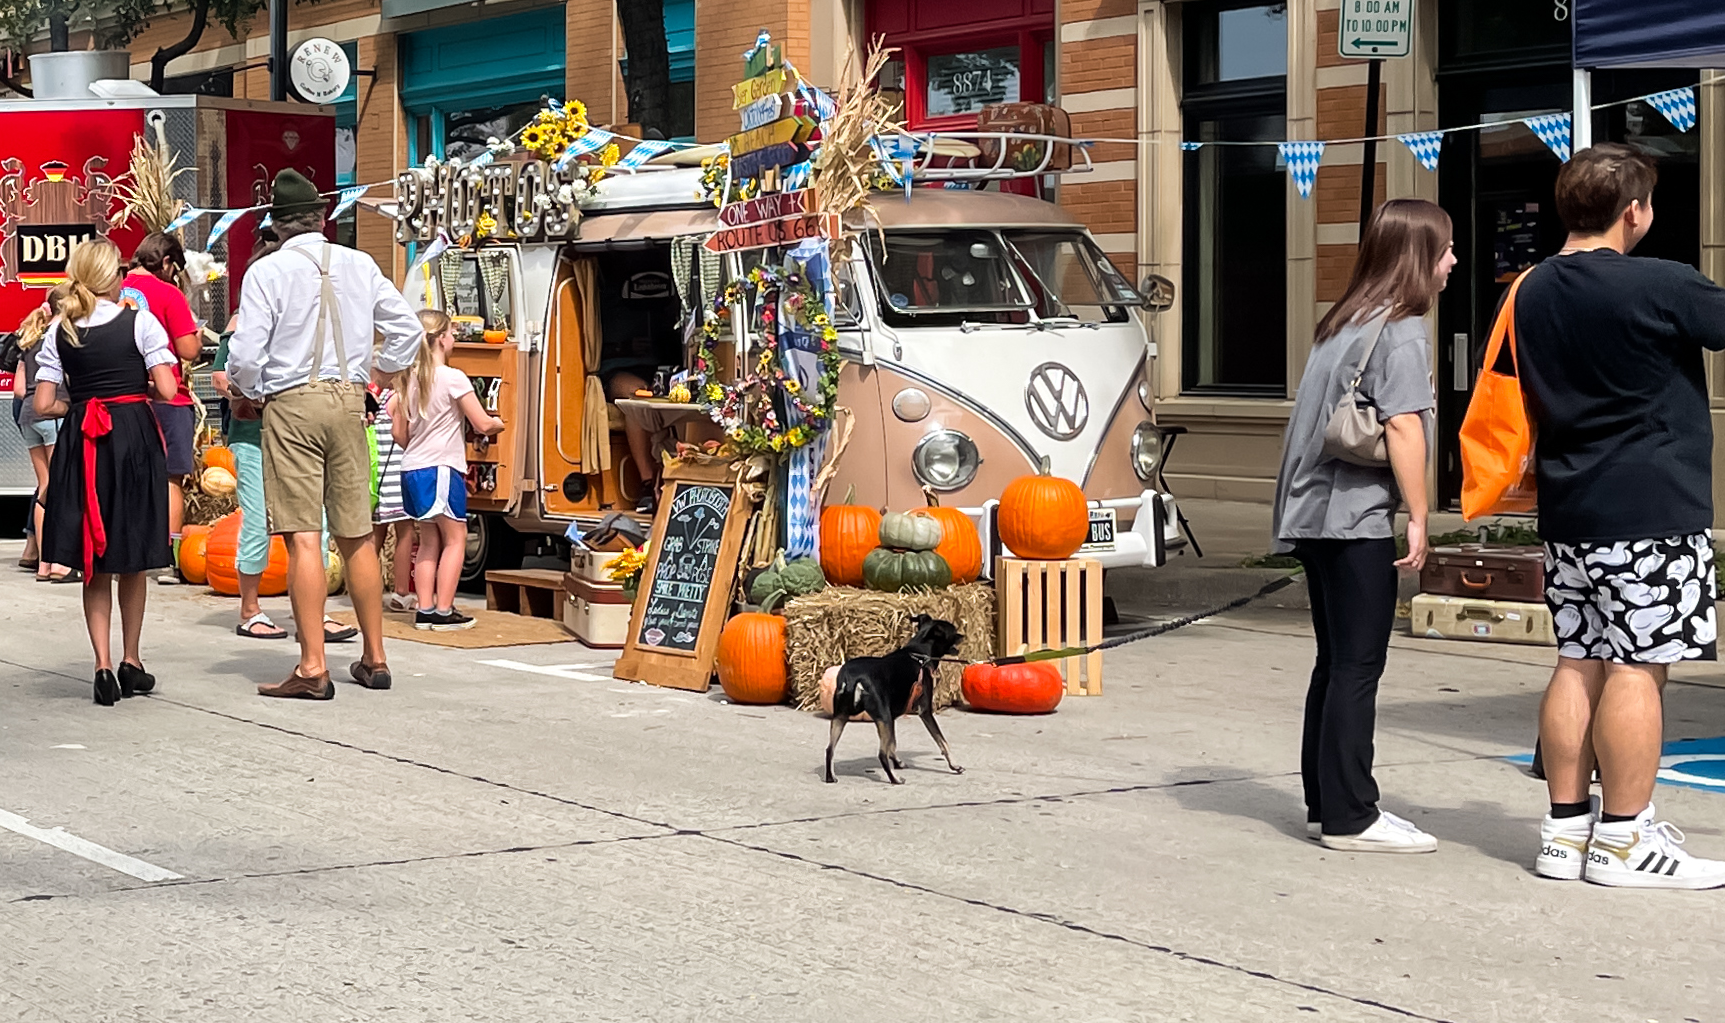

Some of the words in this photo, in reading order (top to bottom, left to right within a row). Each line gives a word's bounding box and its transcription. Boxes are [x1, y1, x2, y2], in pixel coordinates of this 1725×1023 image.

[1384, 0, 1400, 14] AM
[1346, 19, 1359, 33] TO
[1391, 19, 1407, 33] PM
[297, 44, 342, 64] RENEW
[751, 78, 775, 99] Garden
[953, 69, 992, 96] 8874
[396, 158, 582, 243] PHOTOS
[727, 202, 750, 226] ONE
[755, 194, 782, 219] WAY
[717, 225, 763, 251] ROUTE
[794, 217, 816, 239] 66
[672, 493, 686, 514] VW
[1091, 522, 1112, 542] BUS
[663, 536, 684, 553] GRAB
[664, 548, 674, 566] A
[699, 553, 708, 571] A
